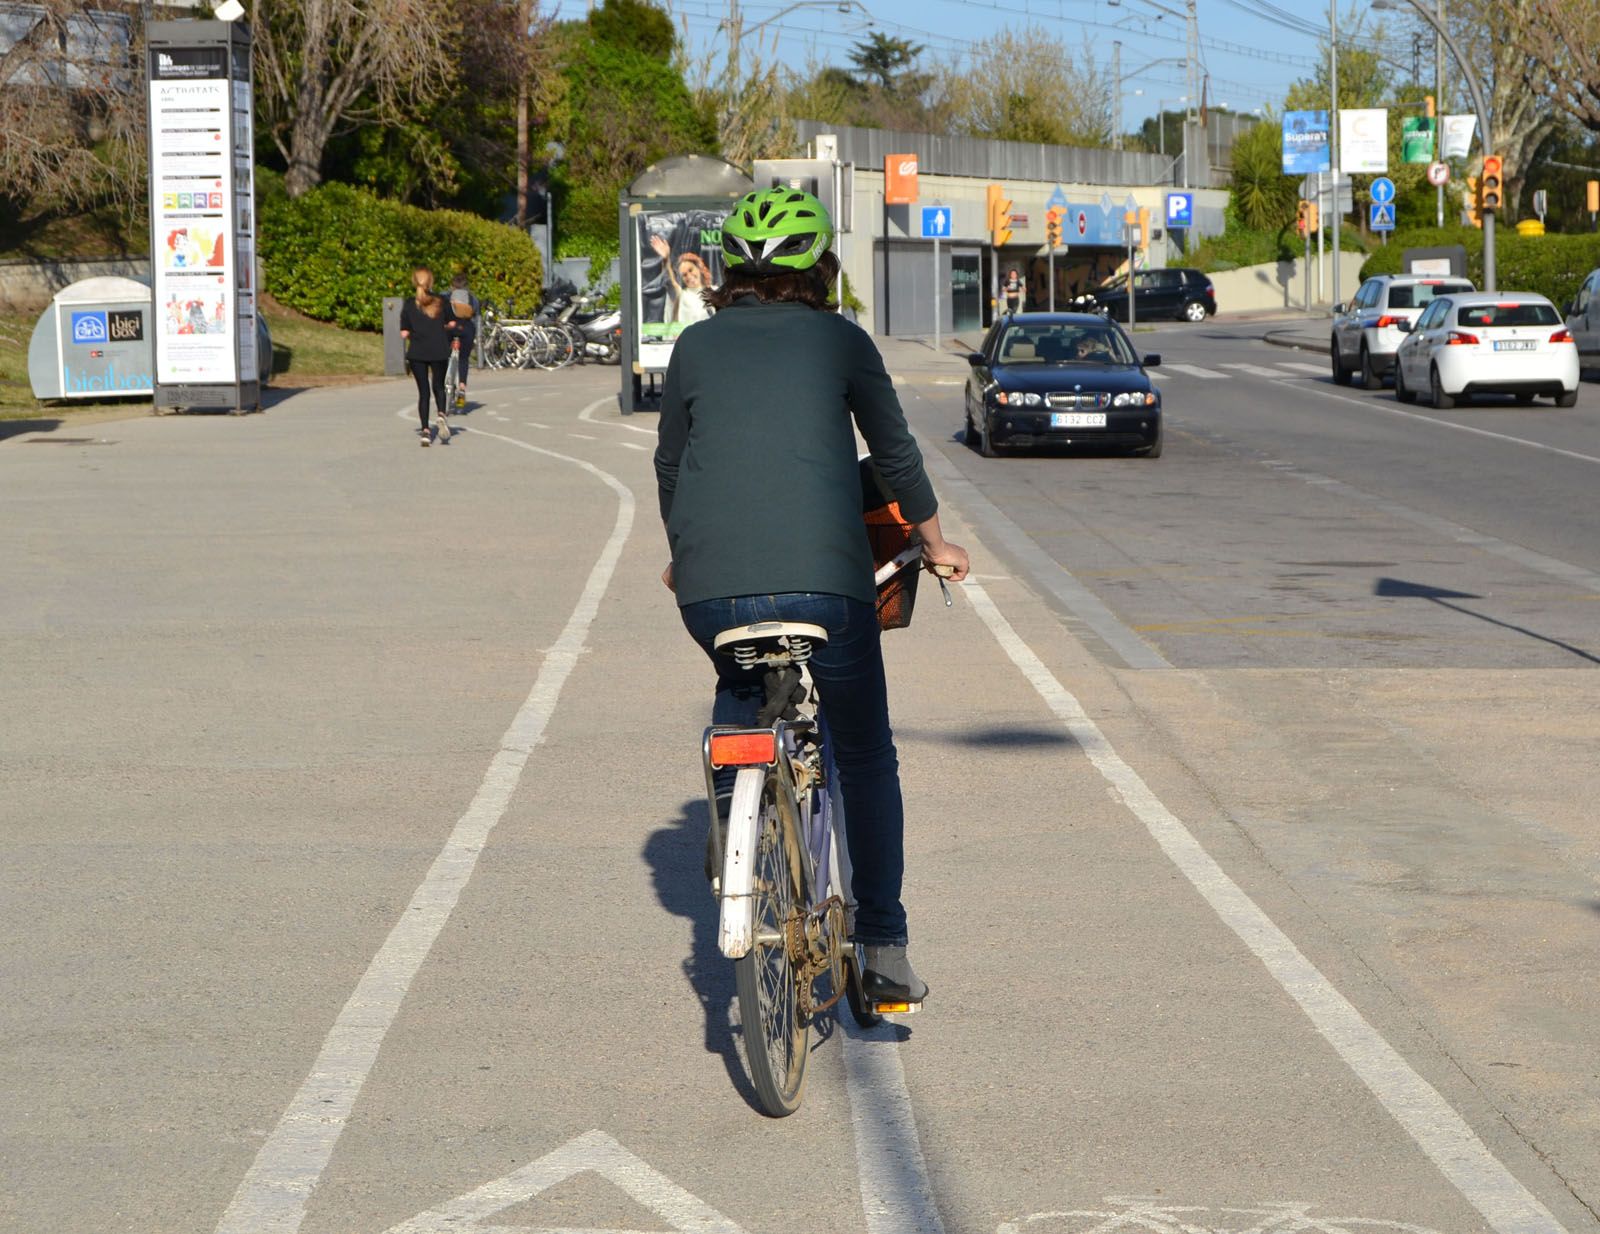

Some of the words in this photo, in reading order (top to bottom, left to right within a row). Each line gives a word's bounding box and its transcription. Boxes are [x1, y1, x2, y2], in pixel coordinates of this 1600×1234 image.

[1169, 196, 1187, 217] P
[115, 315, 140, 330] bici
[112, 323, 137, 338] box
[1057, 415, 1081, 424] 6132
[1086, 415, 1104, 424] CCZ
